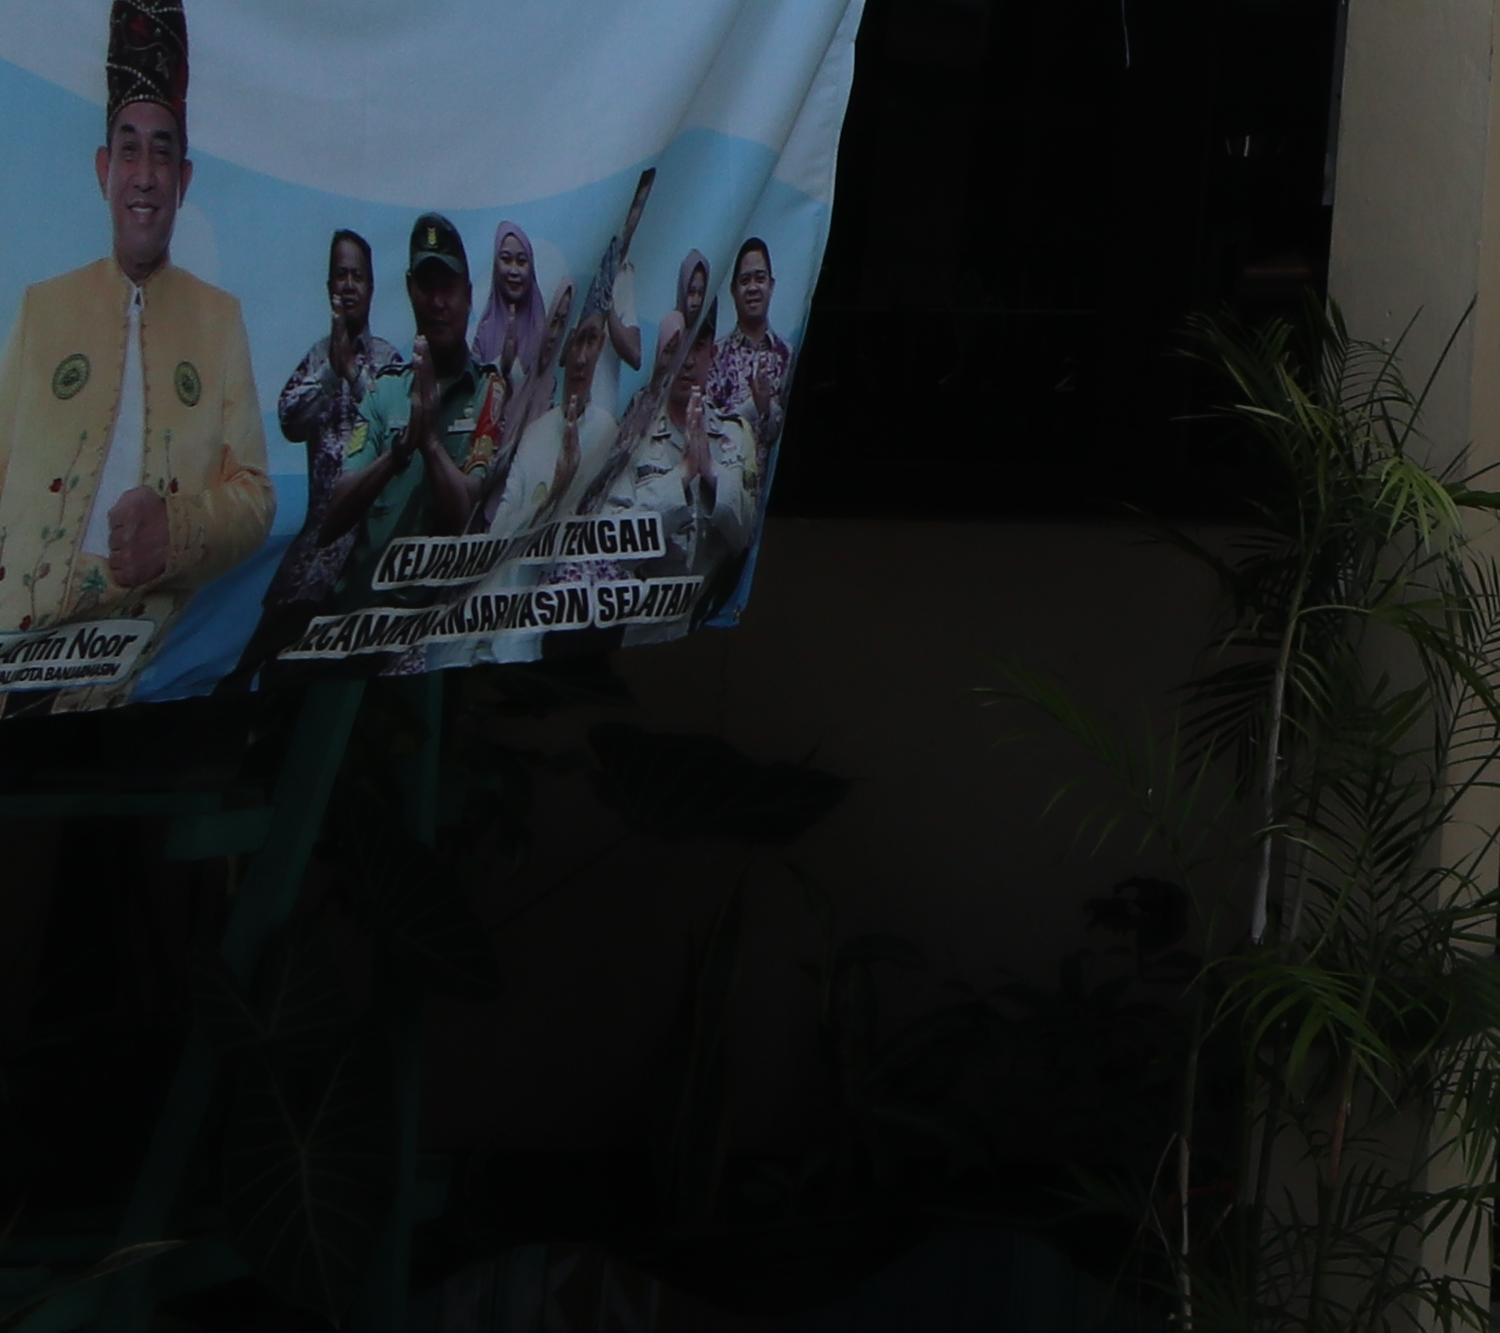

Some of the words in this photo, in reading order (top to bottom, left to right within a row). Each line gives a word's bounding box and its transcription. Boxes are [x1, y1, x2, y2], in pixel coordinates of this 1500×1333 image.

[560, 517, 660, 556] TENGAH
[597, 582, 700, 621] SELATAN
[66, 627, 137, 660] Noor
